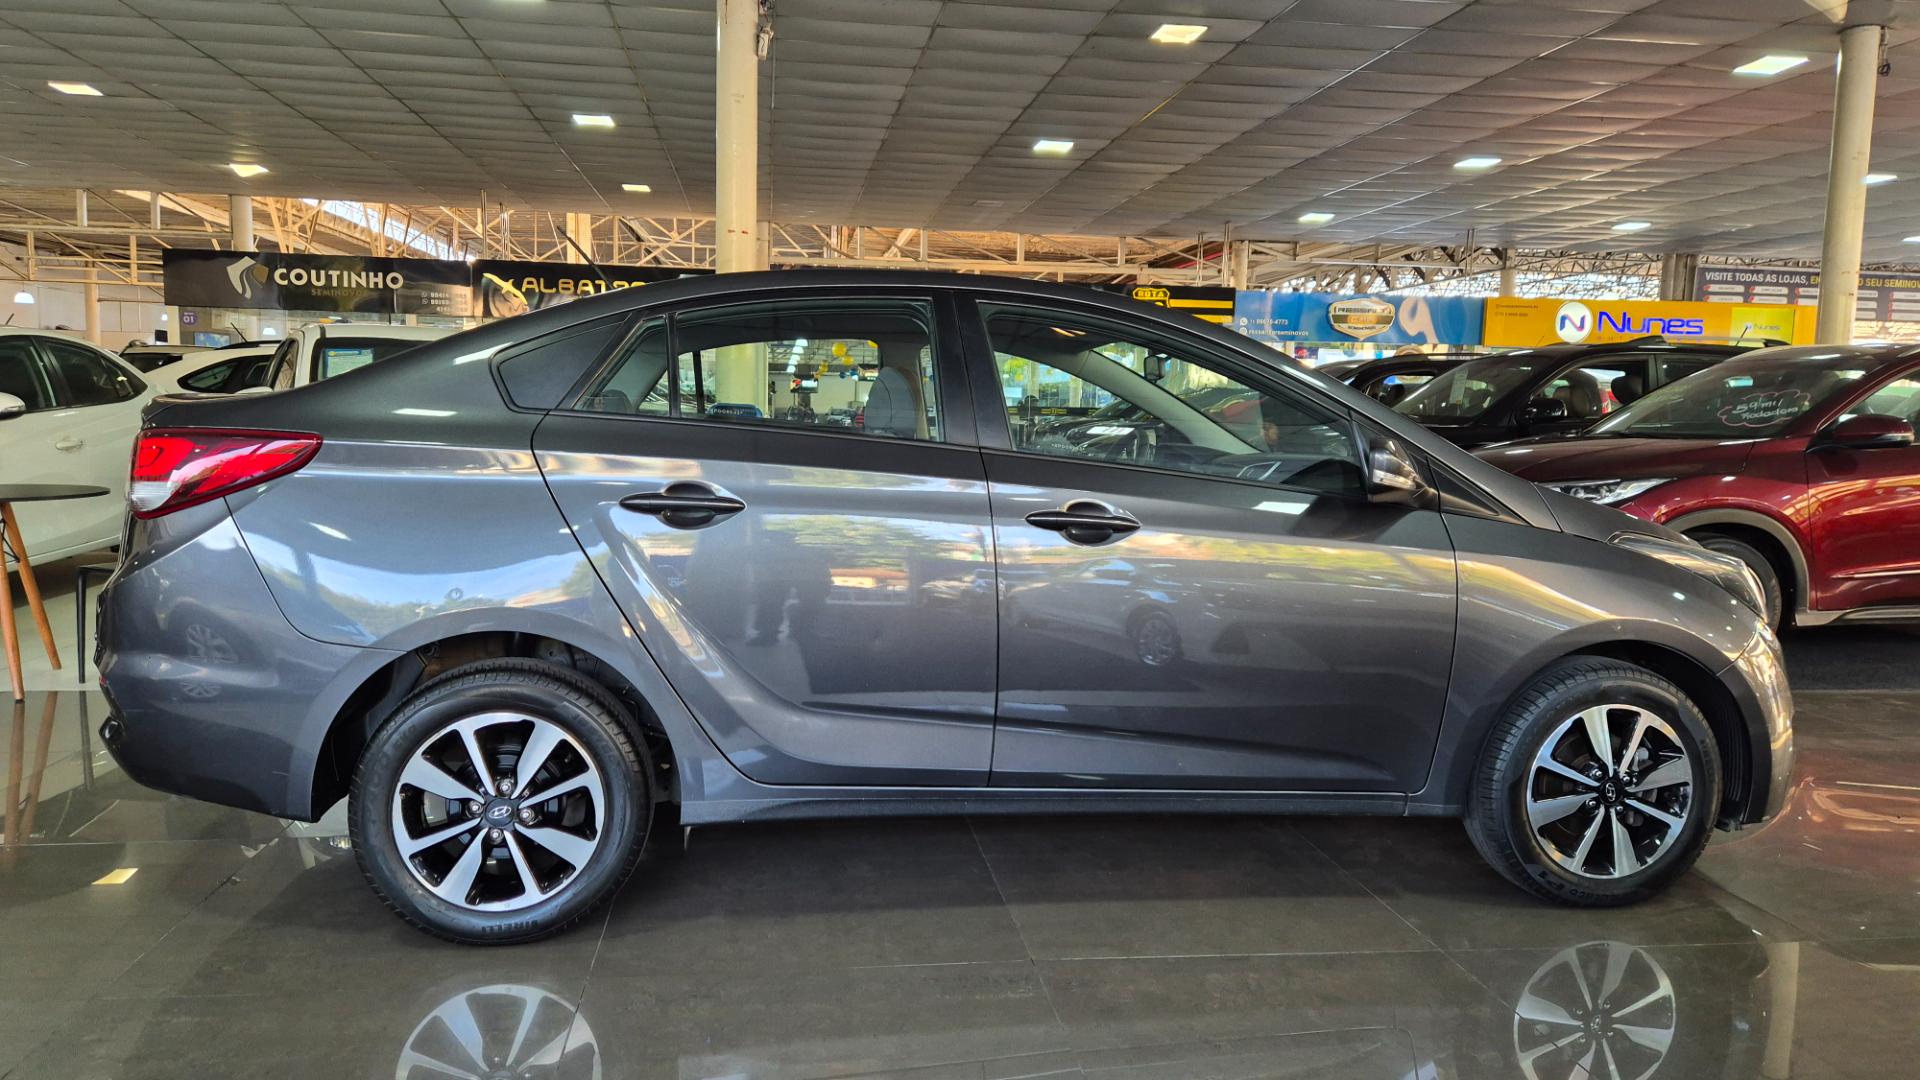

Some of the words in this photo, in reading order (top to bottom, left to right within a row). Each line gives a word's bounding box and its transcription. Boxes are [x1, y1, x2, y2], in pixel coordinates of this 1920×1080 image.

[273, 268, 404, 290] COUTINHO
[1705, 271, 1733, 281] VISITE
[1735, 272, 1763, 282] TODAS
[1765, 273, 1777, 283] AS
[1778, 274, 1808, 285] LOJAS,
[1866, 278, 1883, 287] SEU
[1137, 290, 1165, 298] ROTA
[183, 315, 195, 323] 01
[1597, 311, 1704, 336] Nunes
